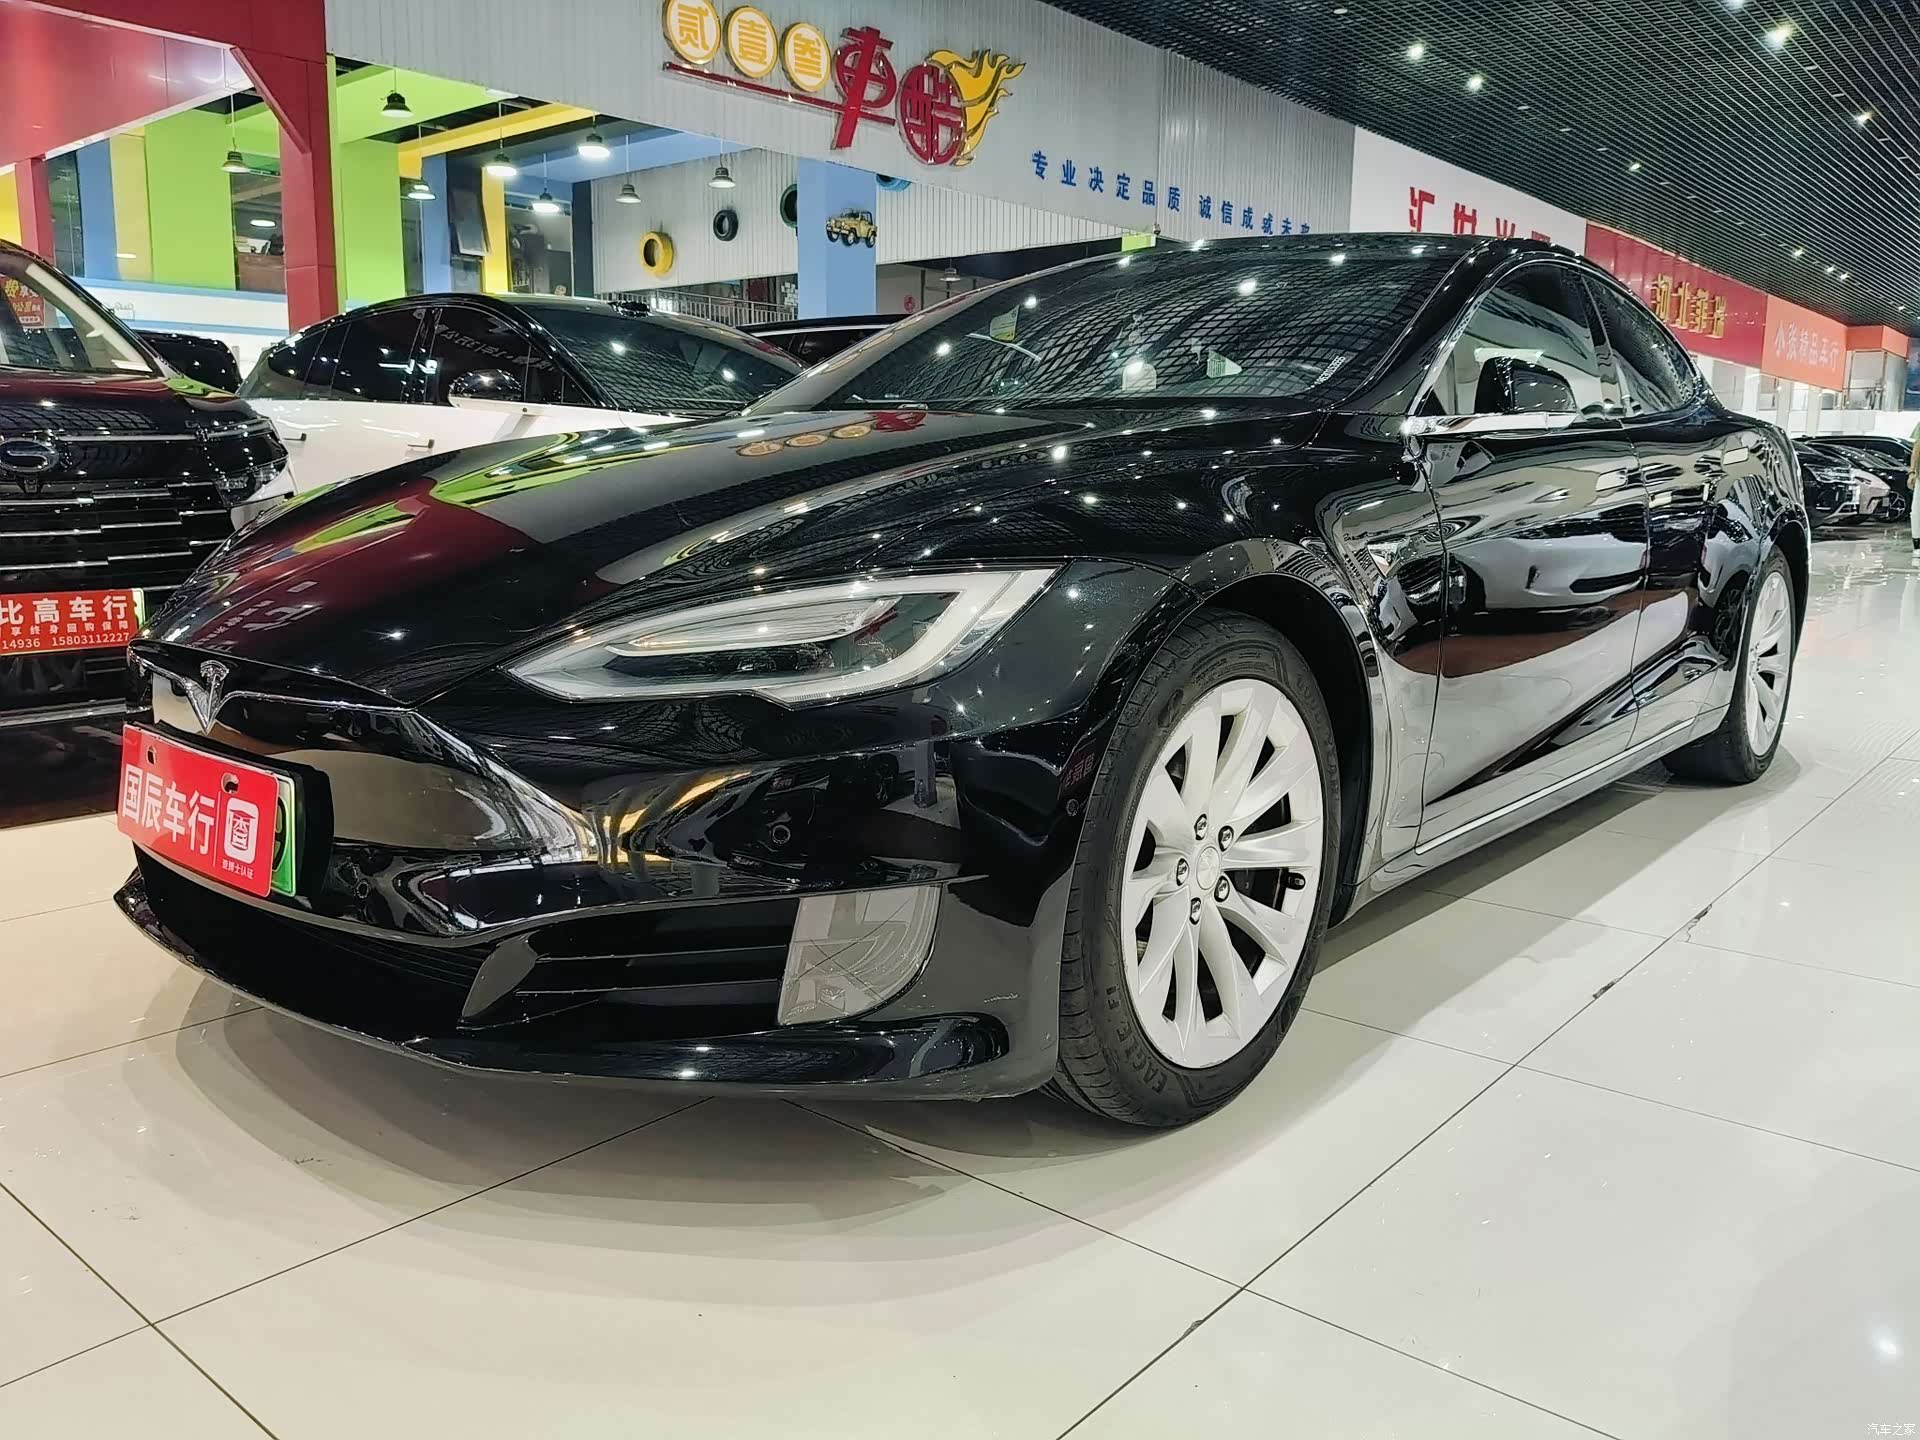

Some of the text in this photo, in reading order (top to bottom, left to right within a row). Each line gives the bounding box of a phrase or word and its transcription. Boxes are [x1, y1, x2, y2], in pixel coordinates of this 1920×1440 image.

[1032, 150, 1181, 213] 专业决定品质
[1775, 320, 1840, 374] 小张精品车行
[0, 595, 128, 625] 比高车行
[0, 620, 129, 637] 享终身回购保障
[2, 632, 130, 650] 14936 15803112227
[122, 763, 216, 855] 国辰车行
